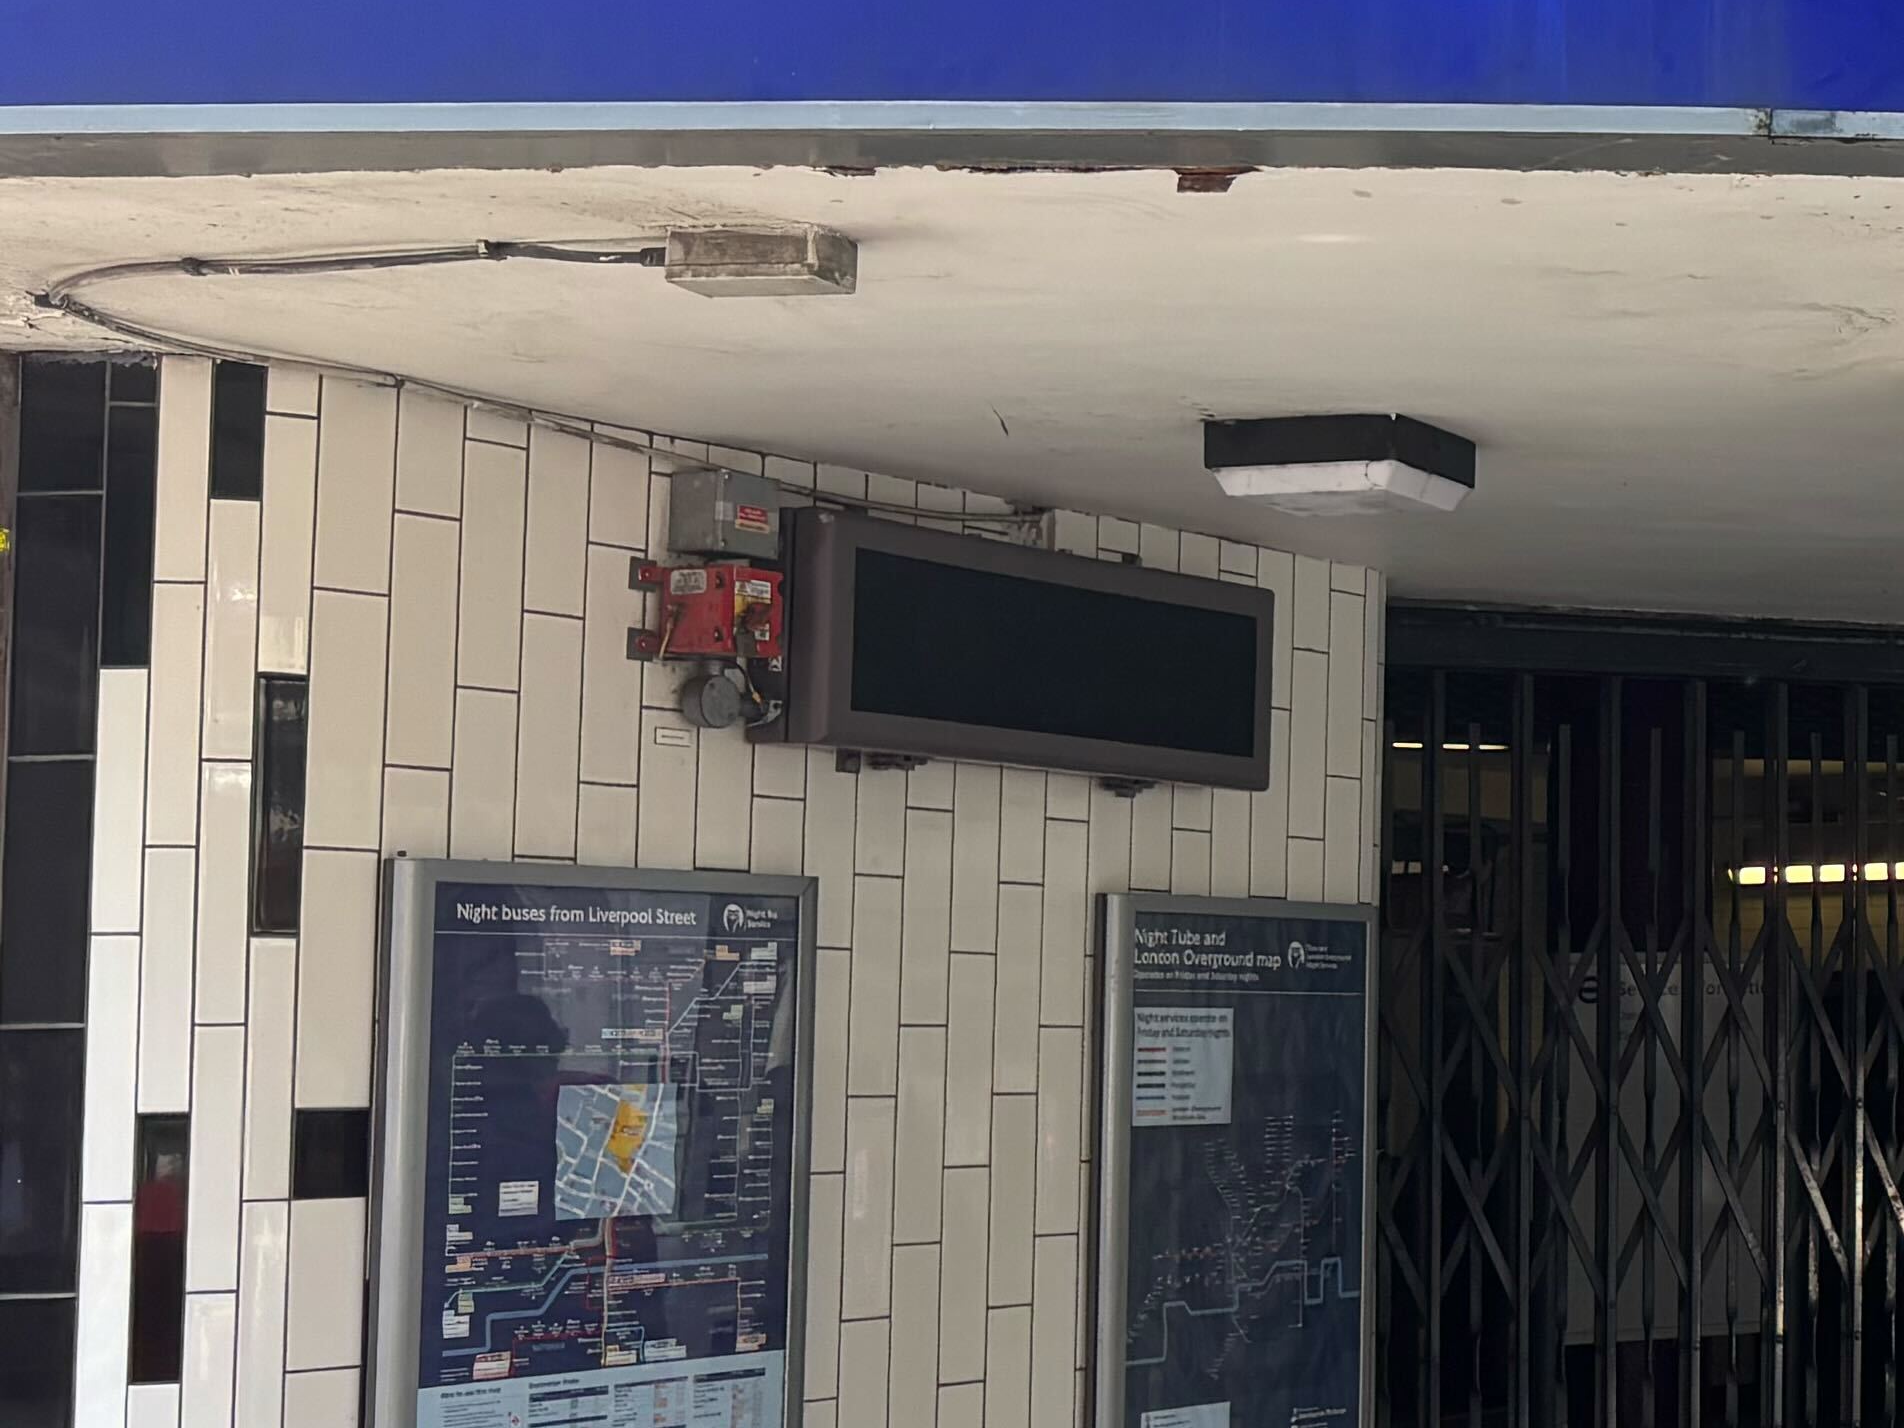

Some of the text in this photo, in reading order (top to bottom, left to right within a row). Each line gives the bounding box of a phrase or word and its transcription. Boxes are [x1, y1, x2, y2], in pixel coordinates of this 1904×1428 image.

[456, 903, 697, 927] Night buses from Liverpool Street
[1134, 928, 1226, 948] Night Tube and
[1134, 947, 1281, 970] London Overground map
